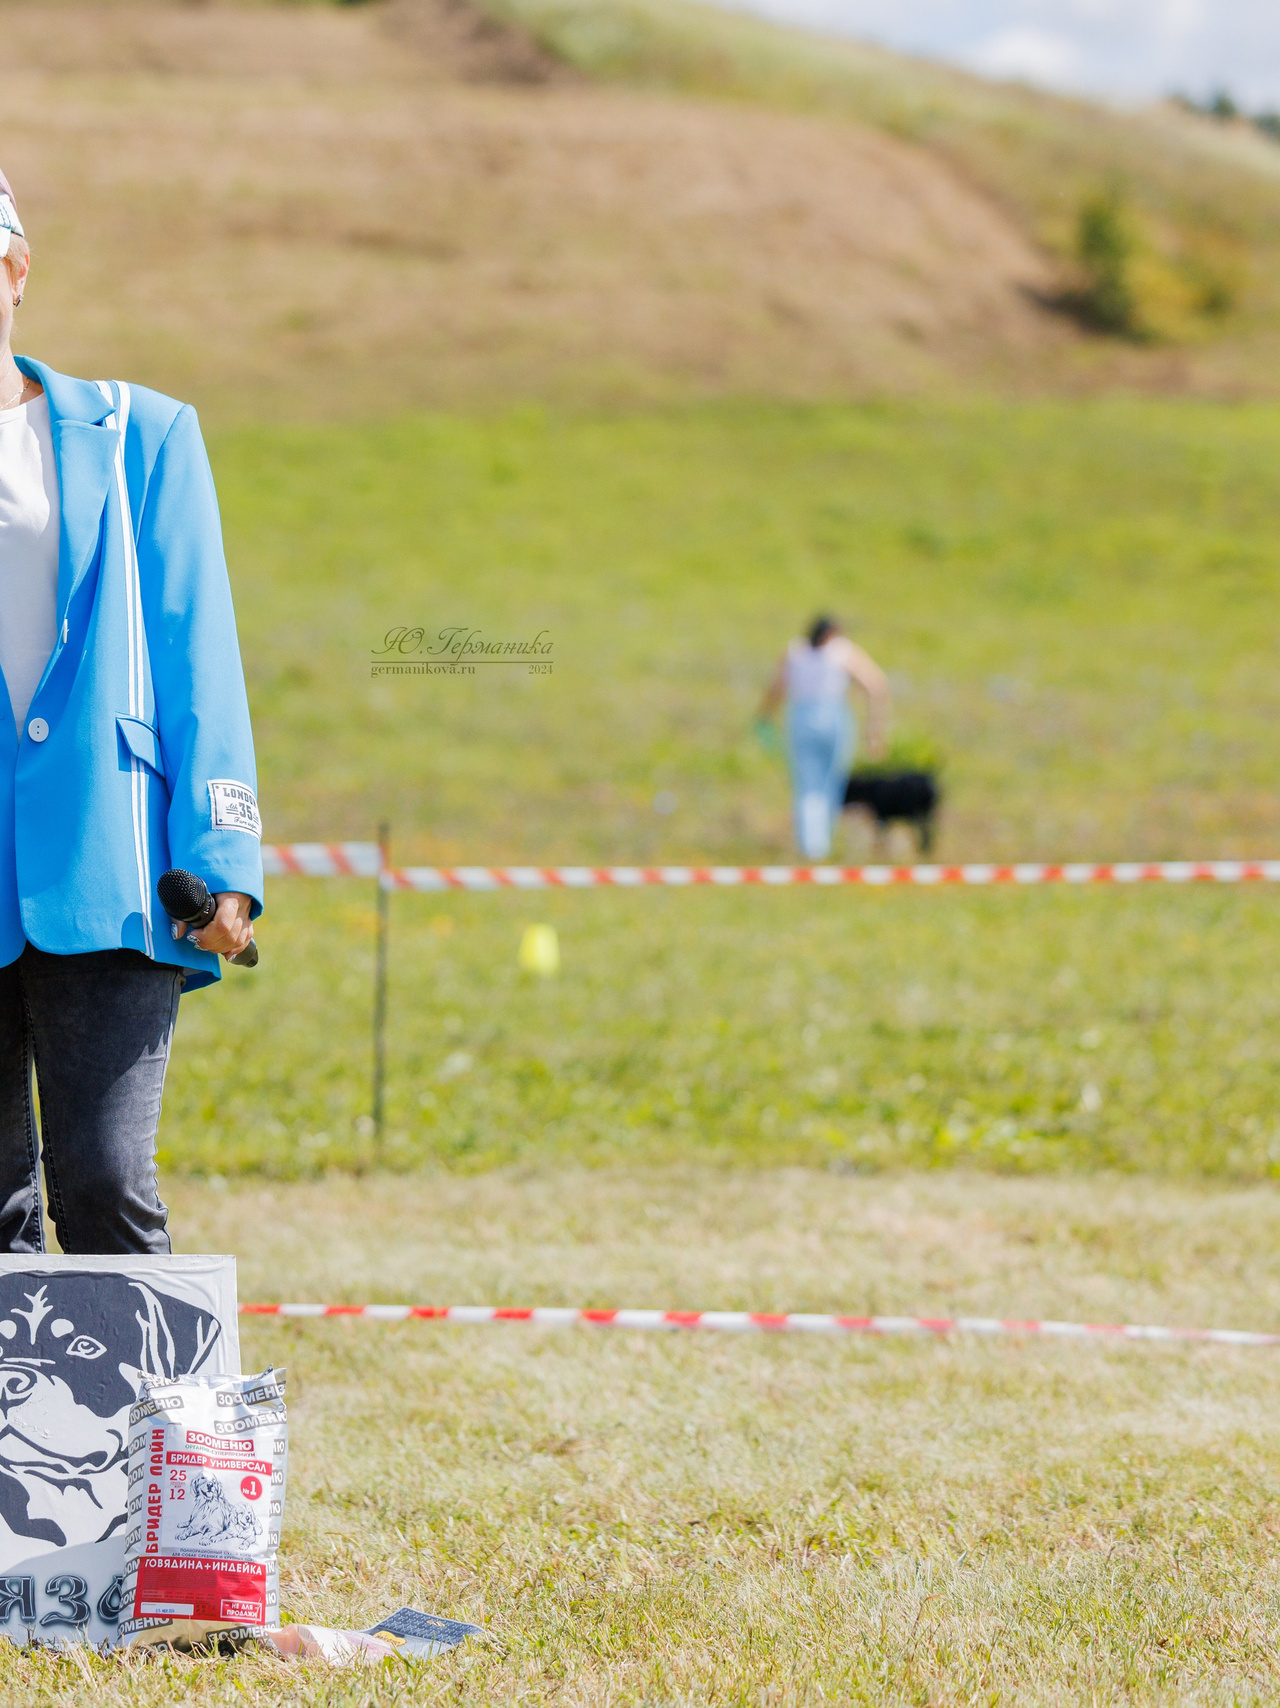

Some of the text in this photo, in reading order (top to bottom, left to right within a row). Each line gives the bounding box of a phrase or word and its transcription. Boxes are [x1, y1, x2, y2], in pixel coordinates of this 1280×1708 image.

[239, 802, 253, 821] 35
[187, 1432, 253, 1451] ЗООМЕНЮ
[170, 1453, 267, 1473] БРИДЕР УНИВЕРСАЛ
[169, 1469, 187, 1481] 25
[145, 1429, 165, 1554] БРИДЕР ЛАЙН
[169, 1488, 186, 1500] 12
